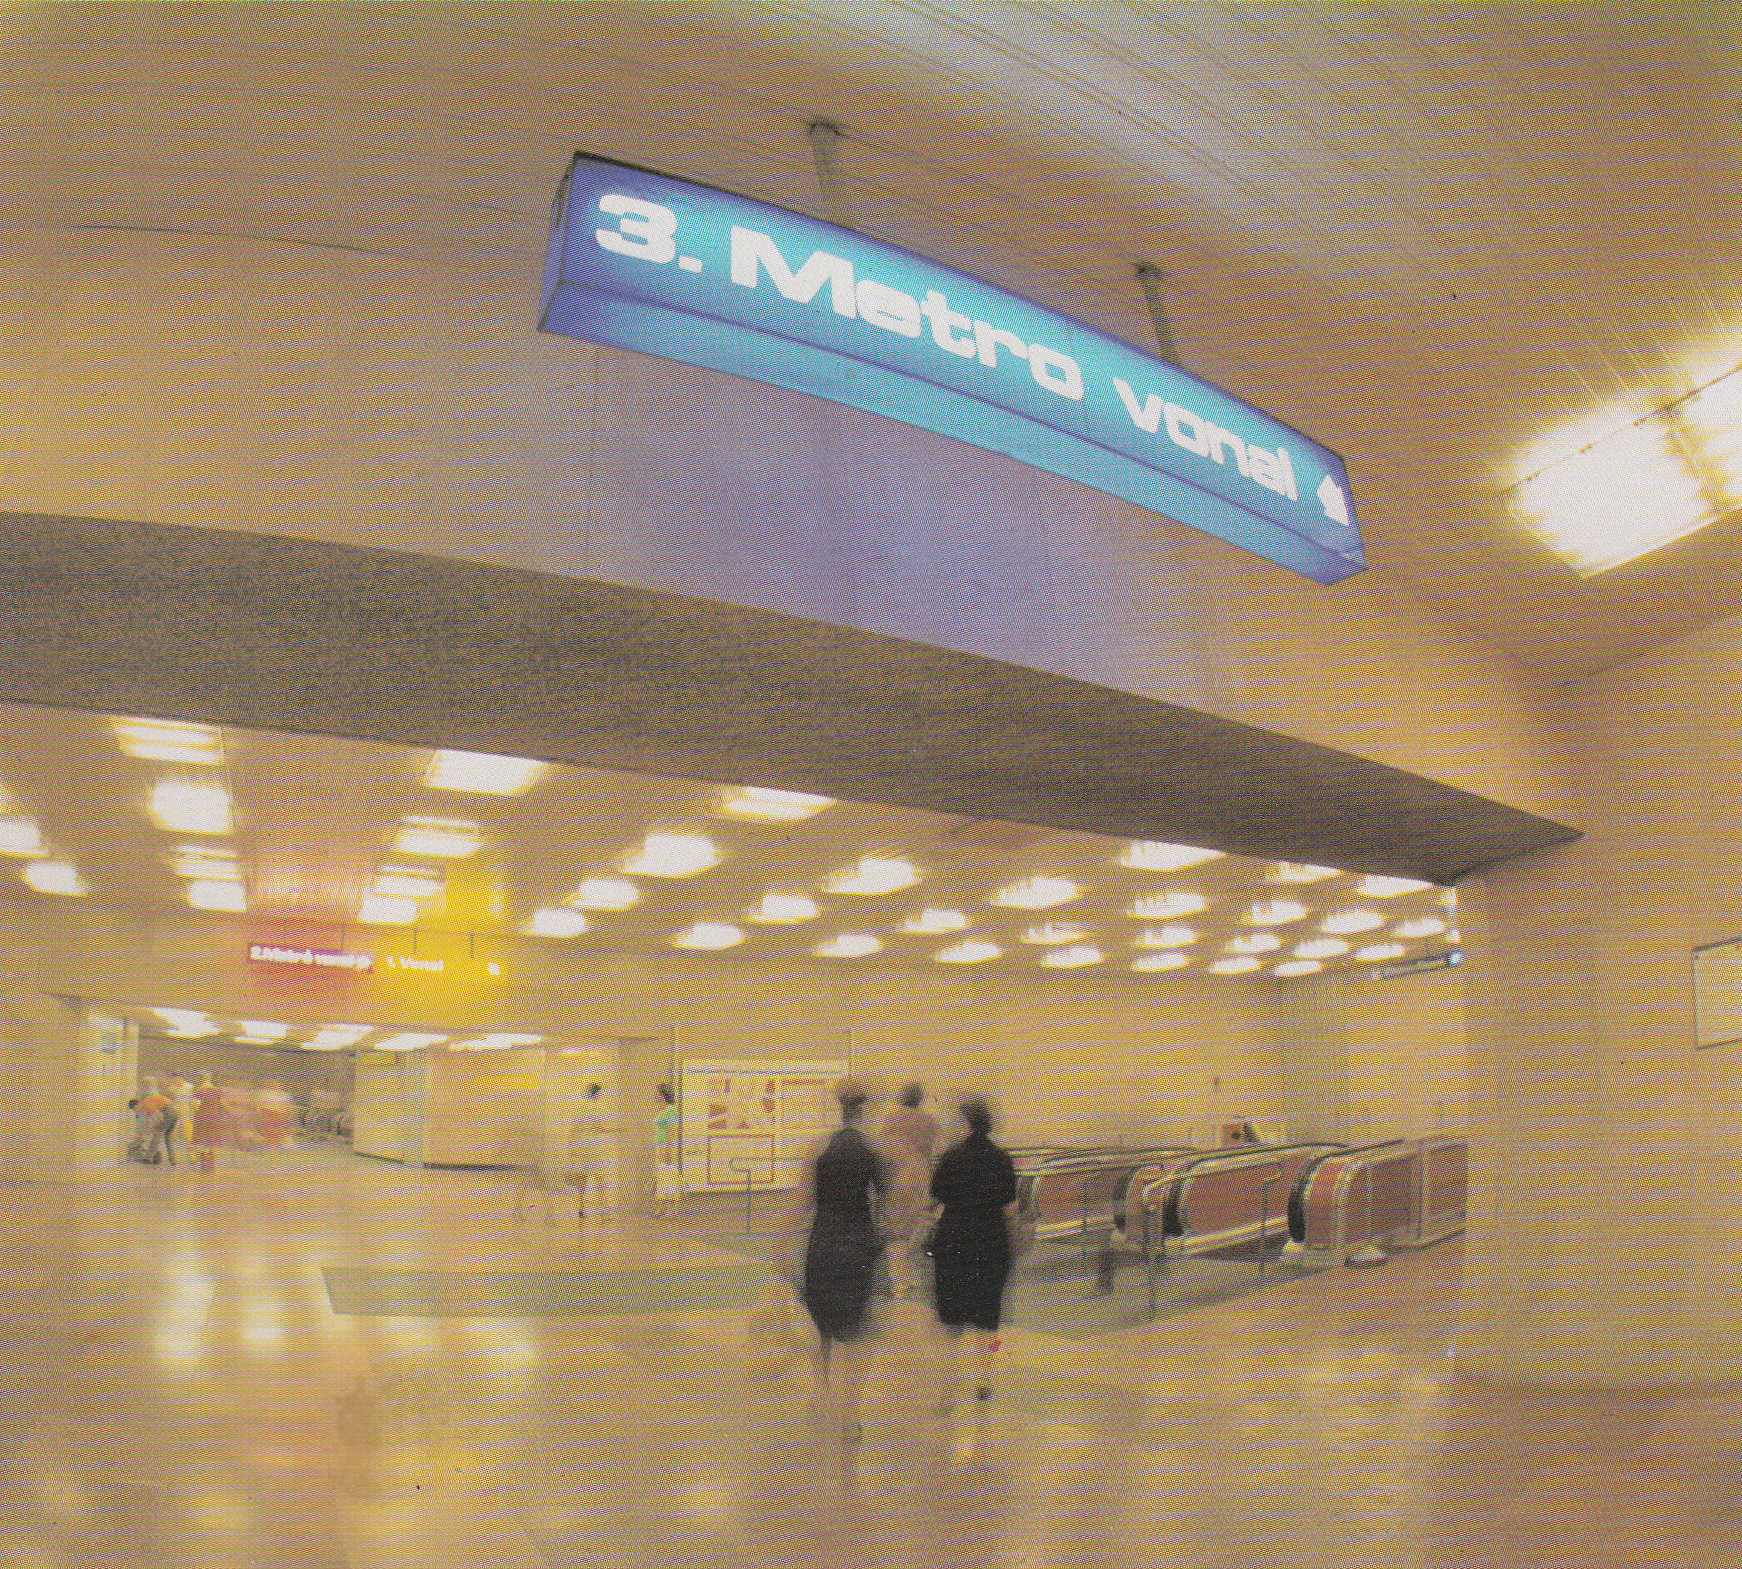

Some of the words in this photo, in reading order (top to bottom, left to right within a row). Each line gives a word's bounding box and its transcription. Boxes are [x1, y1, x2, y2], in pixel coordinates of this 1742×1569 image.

[595, 193, 703, 273] 3.
[730, 225, 1085, 402] Metro
[1112, 377, 1299, 502] vonal
